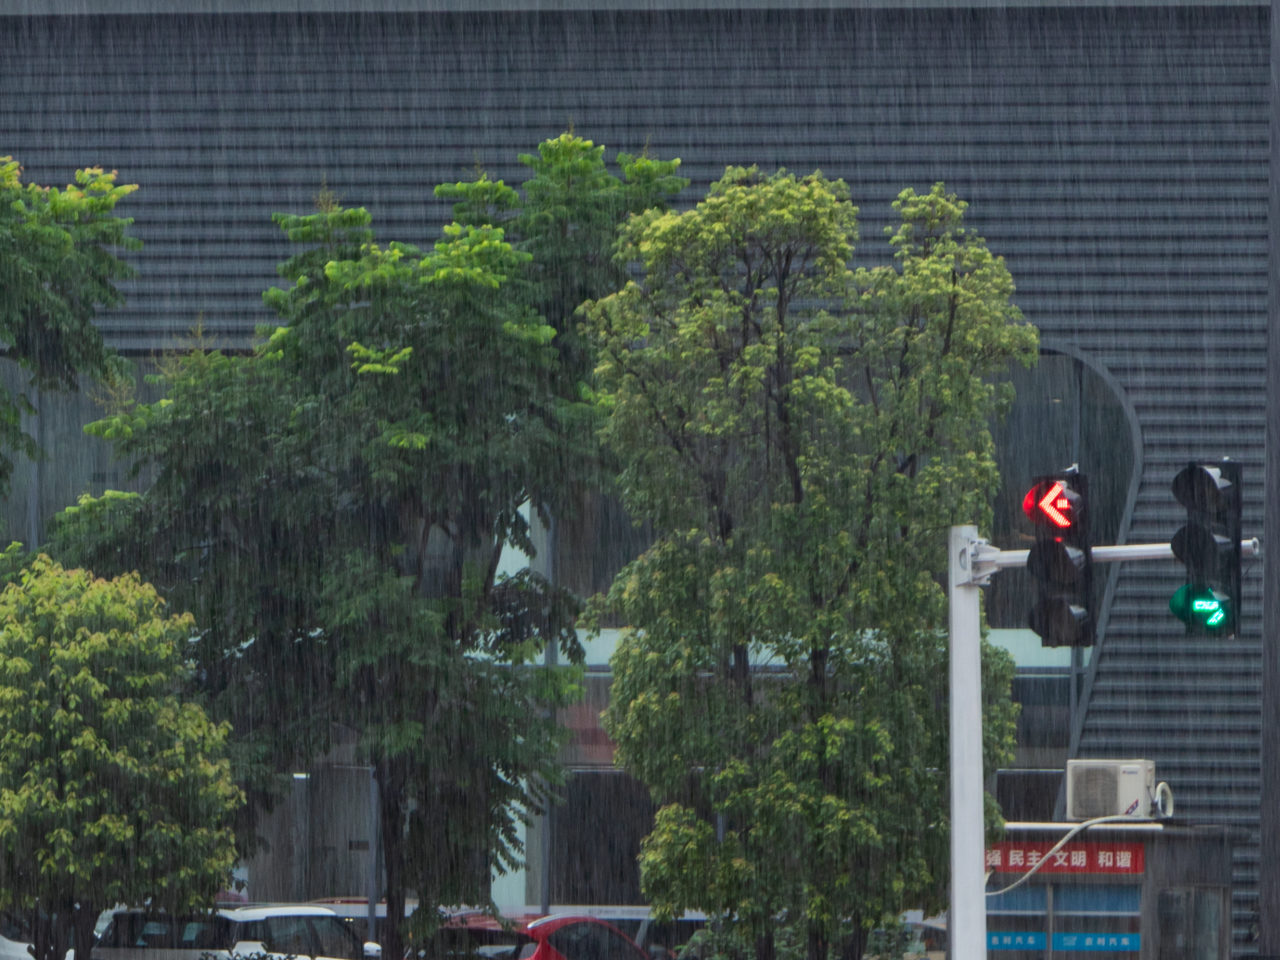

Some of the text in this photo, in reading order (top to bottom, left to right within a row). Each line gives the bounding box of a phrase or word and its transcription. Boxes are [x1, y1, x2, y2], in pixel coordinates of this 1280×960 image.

[1009, 850, 1041, 866] 民主
[1053, 850, 1087, 867] 文明
[1098, 851, 1132, 868] 和谐
